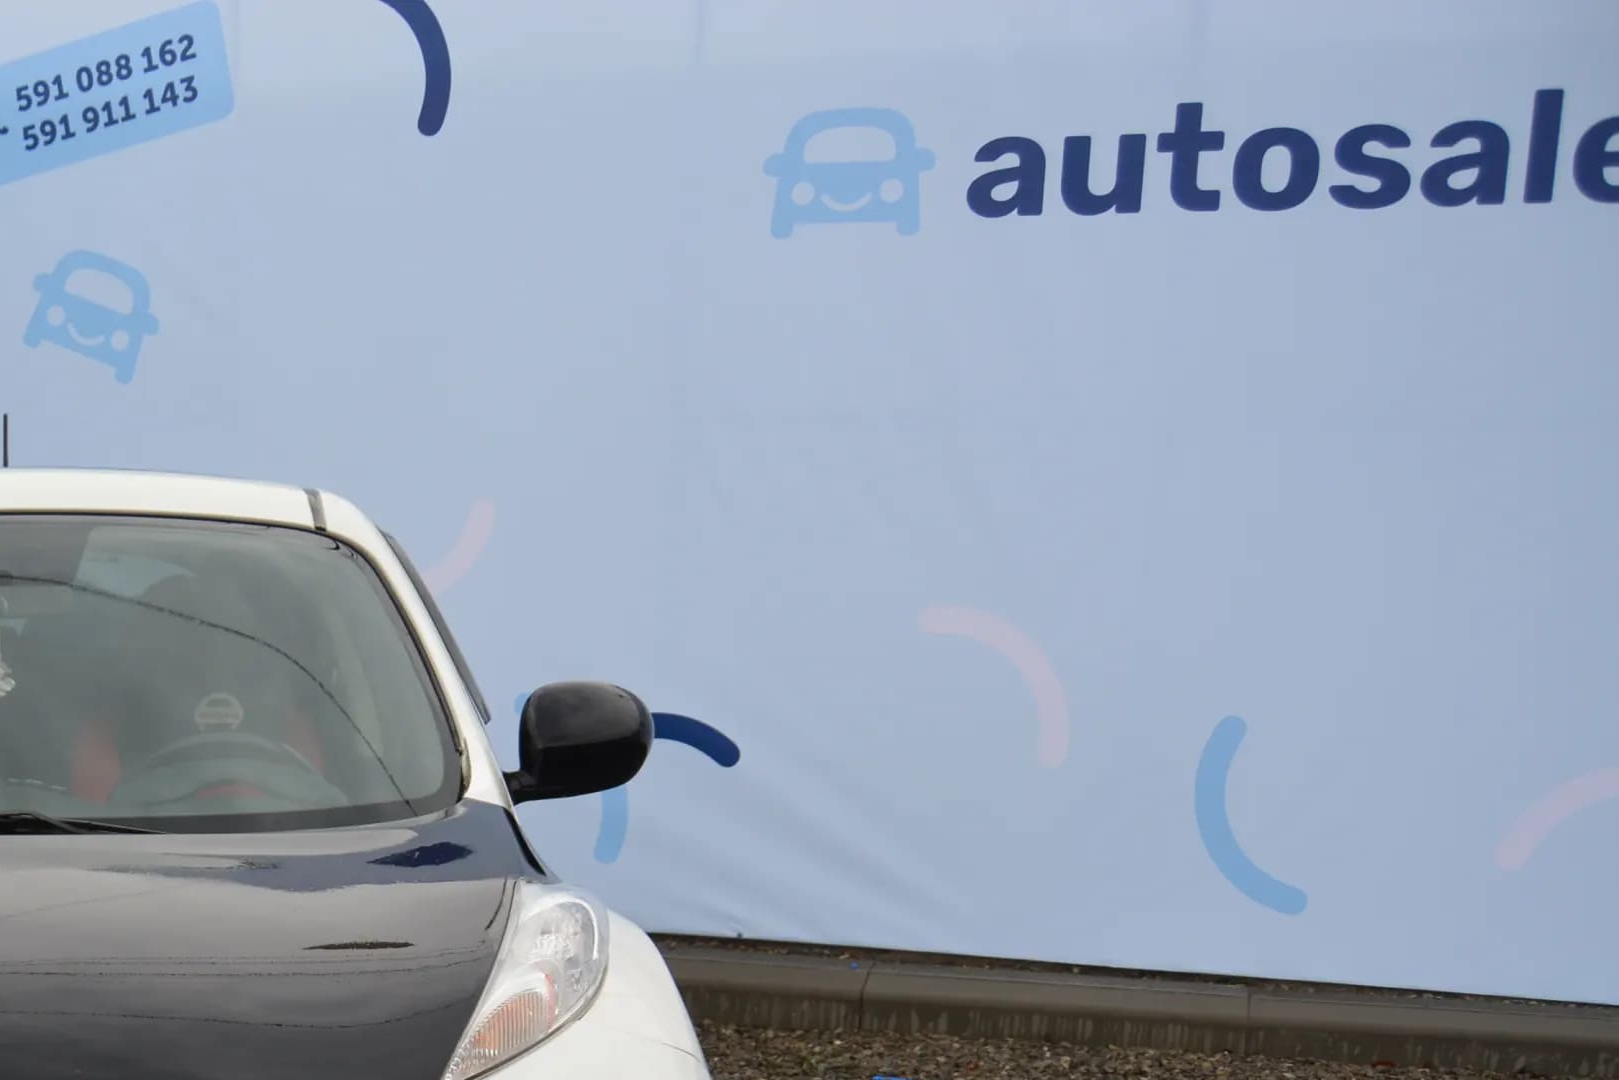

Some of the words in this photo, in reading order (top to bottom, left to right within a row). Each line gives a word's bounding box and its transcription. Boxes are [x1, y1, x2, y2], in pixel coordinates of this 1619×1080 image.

[15, 73, 69, 112] 591
[75, 50, 133, 93] 088
[140, 33, 198, 73] 162
[22, 113, 76, 151] 591
[81, 95, 136, 133] 911
[142, 75, 198, 115] 143
